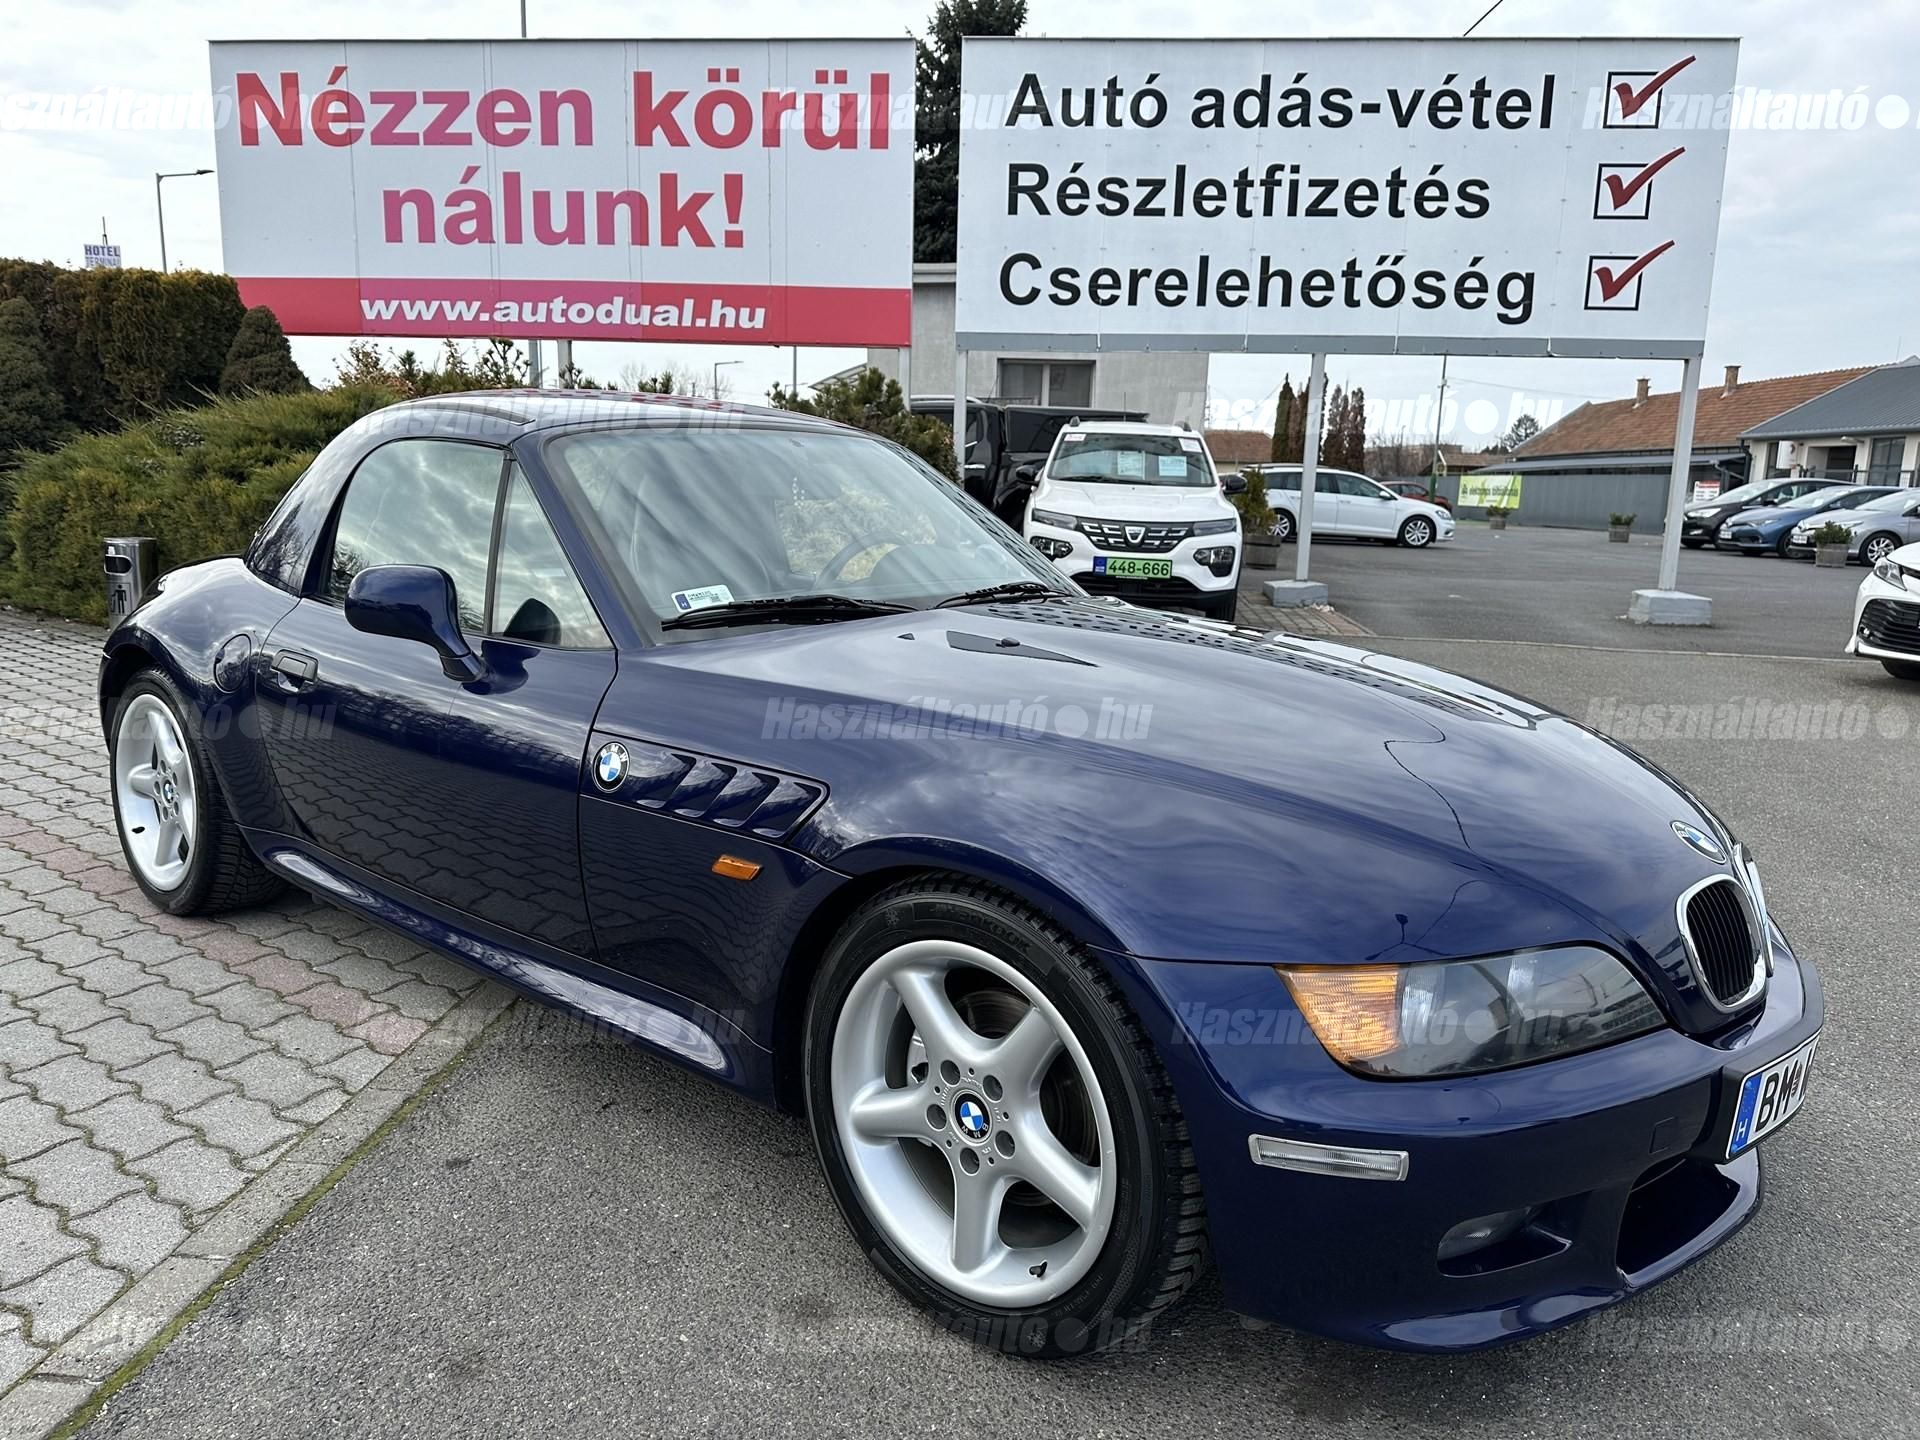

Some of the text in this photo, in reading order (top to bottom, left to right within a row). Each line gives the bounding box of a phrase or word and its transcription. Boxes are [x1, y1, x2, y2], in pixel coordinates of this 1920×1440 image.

[237, 66, 889, 150] Nézzen körül
[1005, 73, 1555, 129] Autó adás-vétel
[384, 166, 743, 248] nálunk!
[1007, 162, 1490, 219] Részletfizetés
[84, 244, 121, 257] HOTEL
[999, 252, 1535, 325] Cserelehetőség
[361, 296, 766, 330] www.autodual.hu
[1108, 559, 1170, 577] 448-666
[600, 744, 627, 762] BMW
[1736, 1118, 1748, 1141] H
